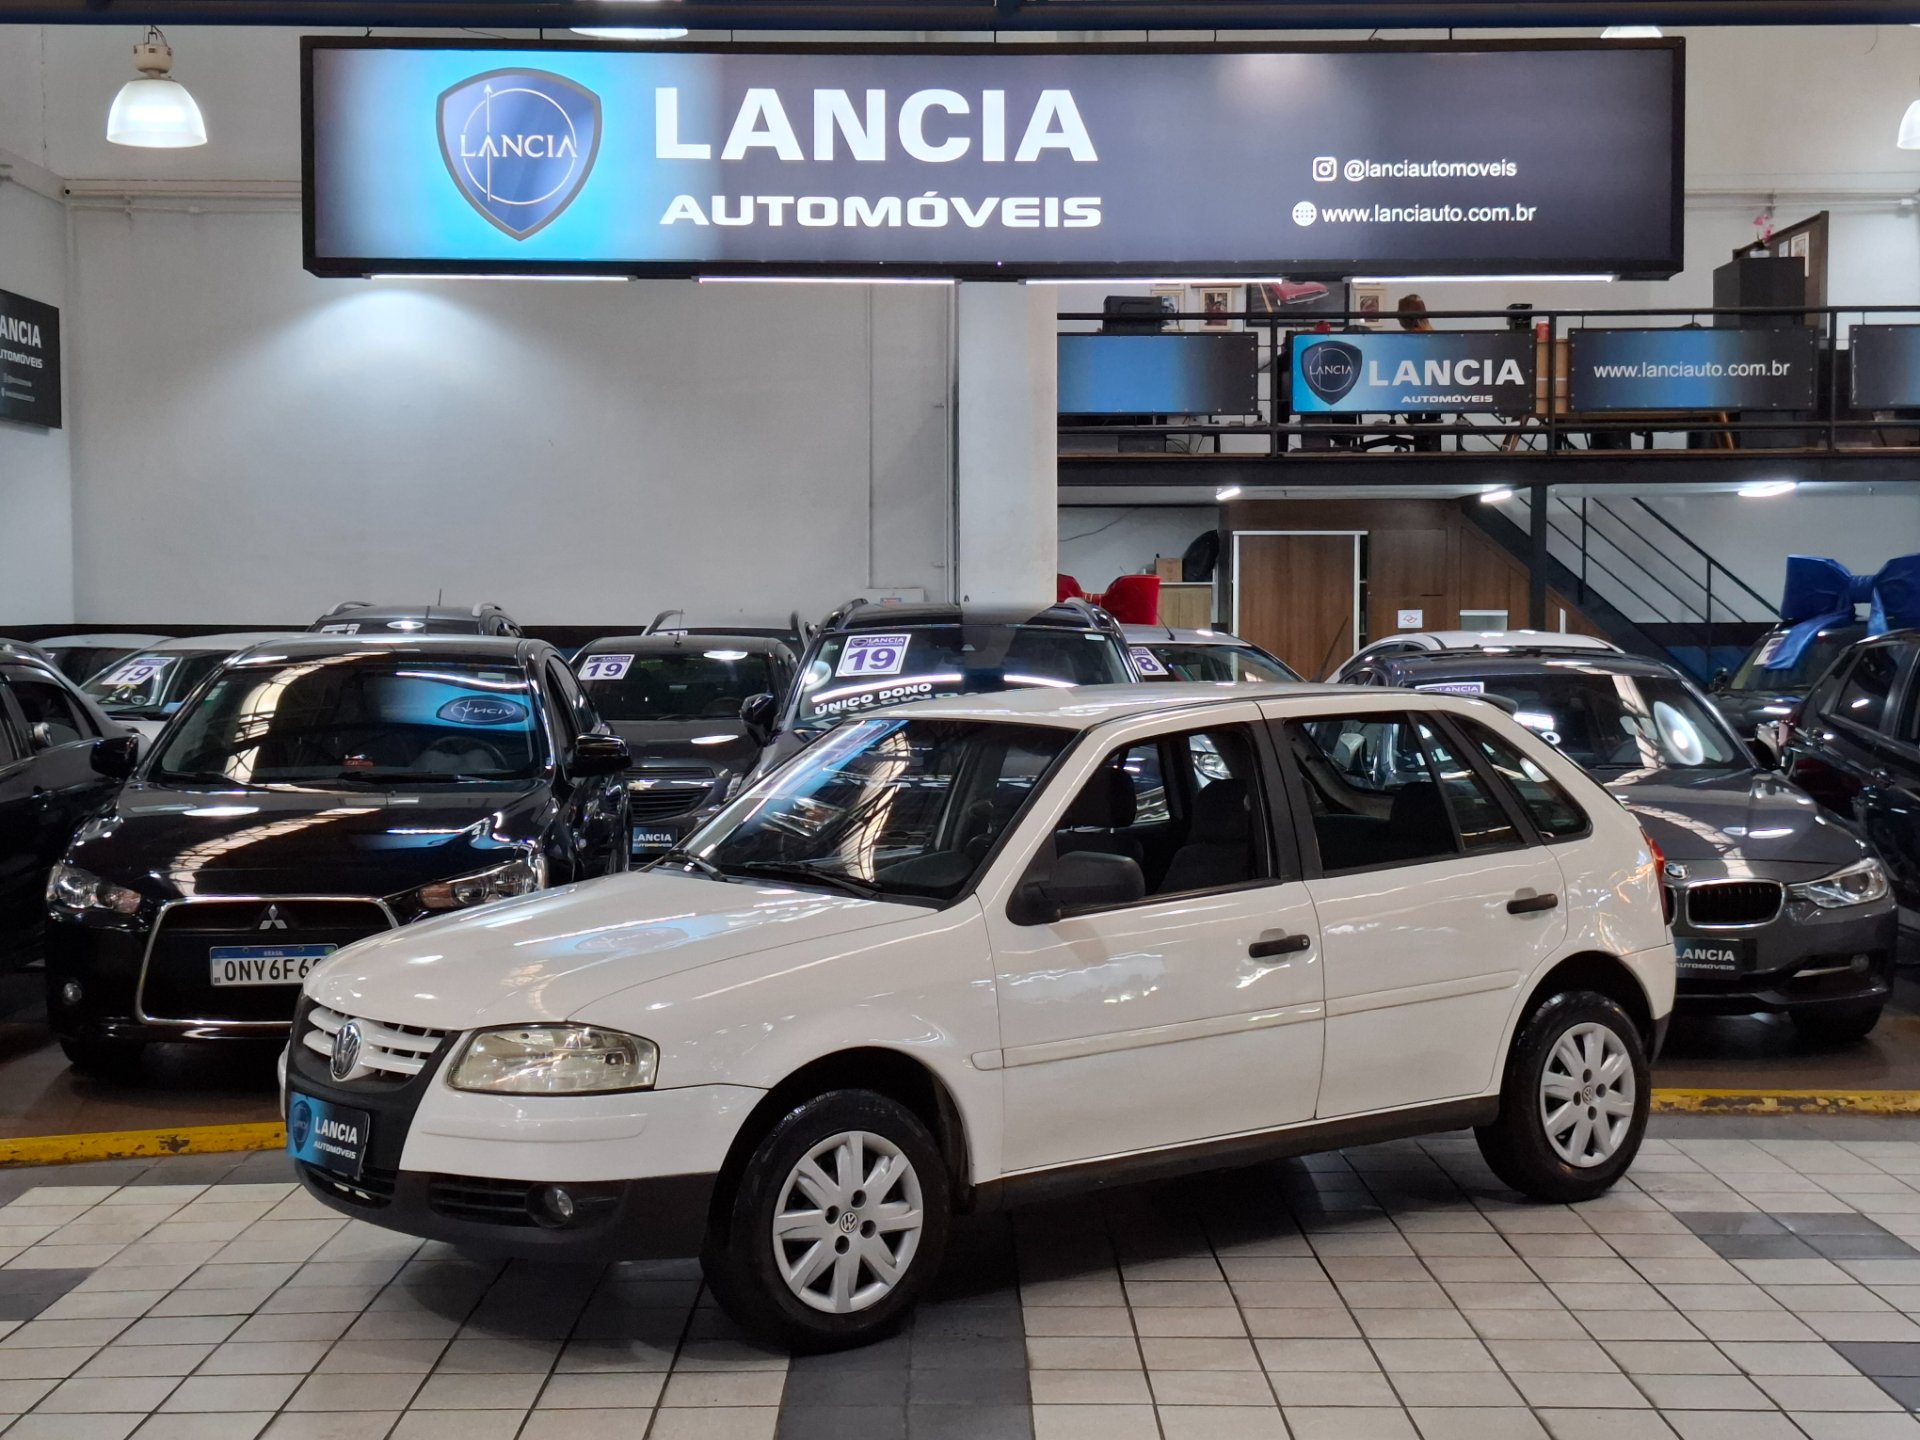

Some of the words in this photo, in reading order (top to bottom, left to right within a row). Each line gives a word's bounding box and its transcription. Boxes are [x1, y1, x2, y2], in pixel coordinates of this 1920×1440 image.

[655, 86, 1099, 163] LANCIA
[460, 133, 578, 158] LANCIA
[1343, 157, 1518, 182] @lanciautomoveis
[659, 190, 1102, 228] AUTOMÓVEIS
[1321, 203, 1538, 223] www.lanciauto.com.br
[0, 315, 42, 349] ANCIA
[1309, 365, 1354, 376] LANCIA
[1368, 359, 1525, 387] LANCIA
[1593, 360, 1791, 379] www.lanciauto.com.br
[1401, 393, 1494, 404] AUTOMÓVEIS
[868, 637, 904, 645] LANCIA
[587, 663, 623, 677] 19
[848, 648, 897, 670] 19
[116, 666, 154, 681] 19
[814, 694, 874, 715] ÚNICO
[878, 683, 932, 700] DONO
[315, 1116, 358, 1145] LANCIA
